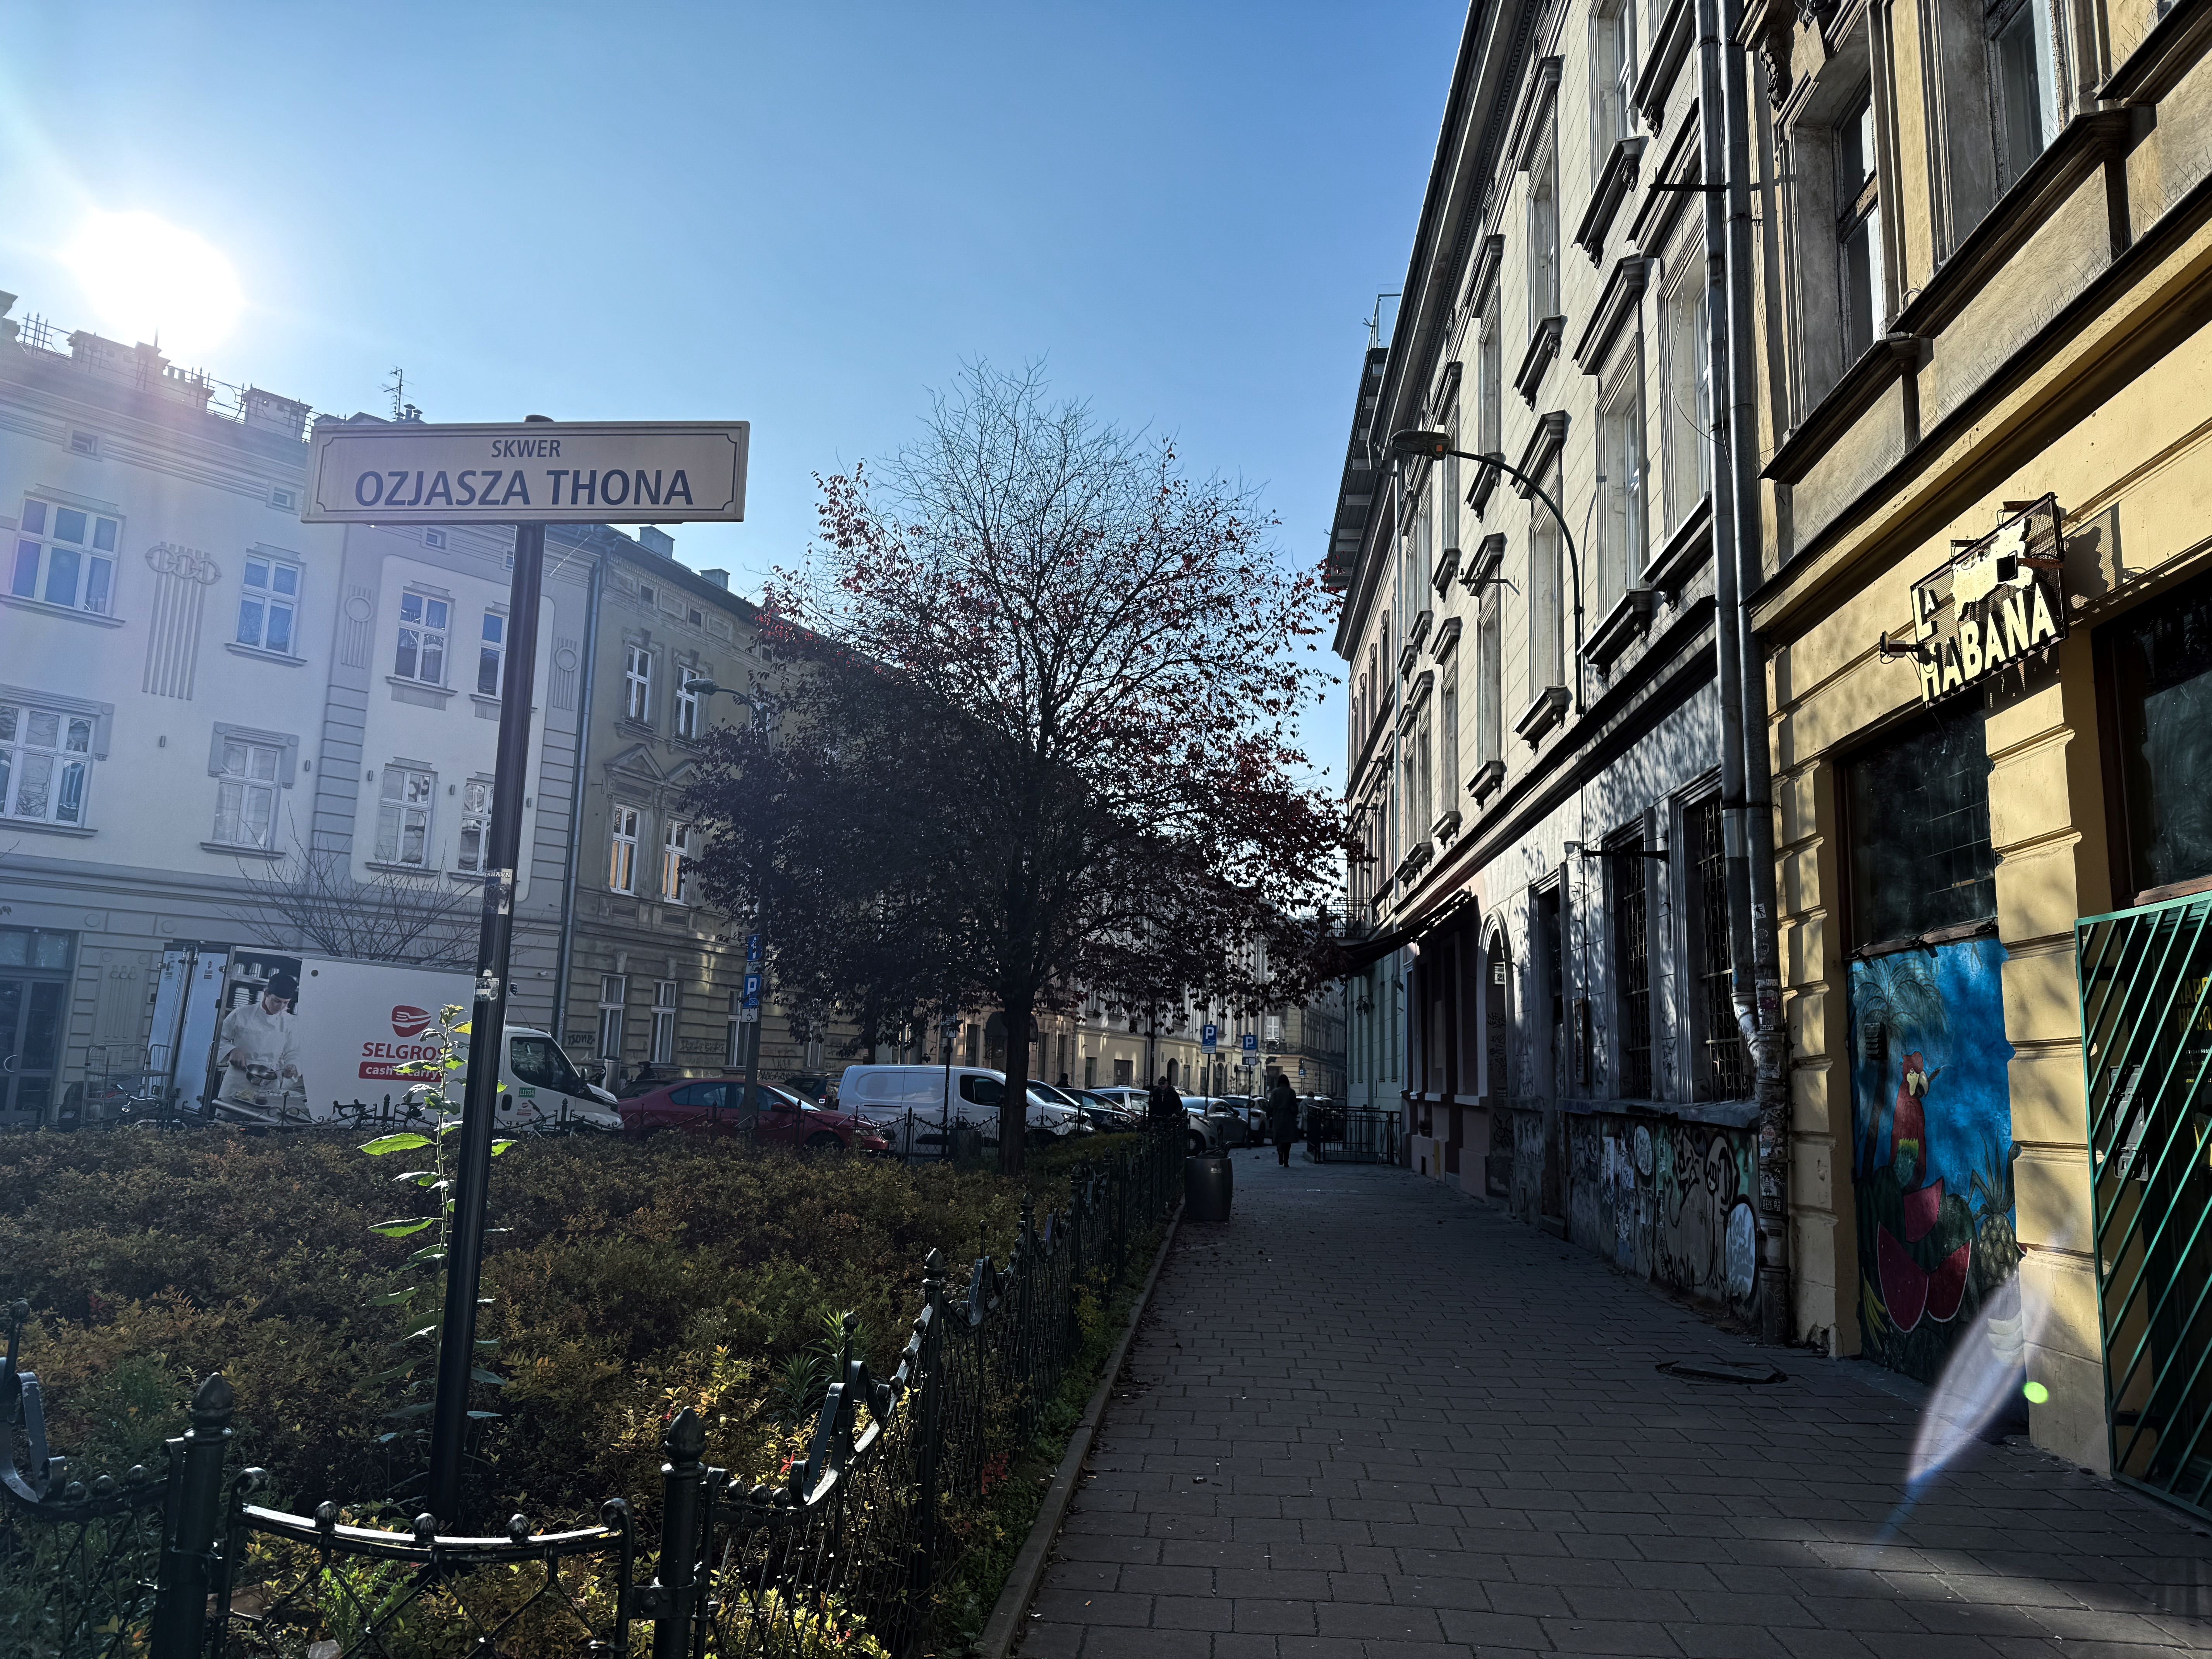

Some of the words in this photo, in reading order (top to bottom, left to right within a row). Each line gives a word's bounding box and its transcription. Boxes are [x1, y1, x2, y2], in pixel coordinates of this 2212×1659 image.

[491, 440, 561, 458] SKWER
[355, 470, 531, 507] OZJASZA
[546, 470, 694, 505] THONA
[1912, 588, 1935, 642] LA
[1919, 582, 2056, 702] HABANA
[747, 978, 757, 995] P
[1206, 1027, 1214, 1039] P
[1246, 1036, 1254, 1048] P
[366, 1066, 393, 1075] cash
